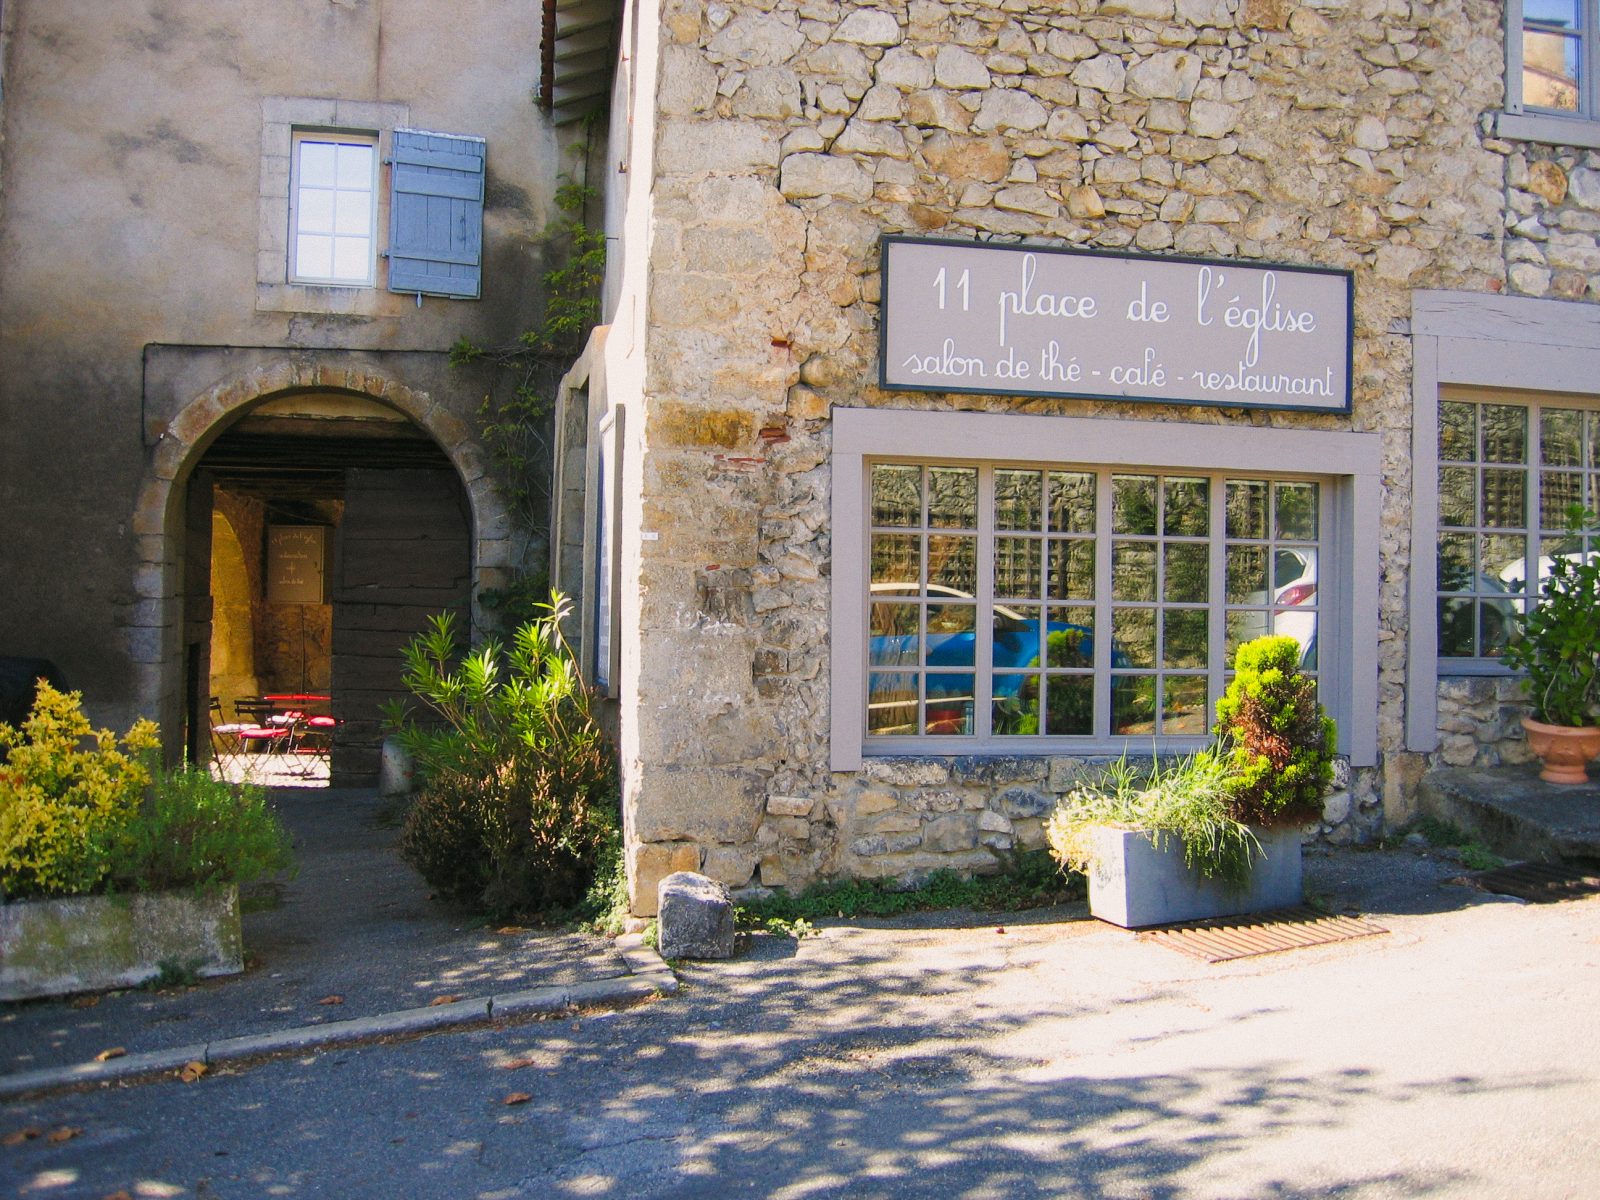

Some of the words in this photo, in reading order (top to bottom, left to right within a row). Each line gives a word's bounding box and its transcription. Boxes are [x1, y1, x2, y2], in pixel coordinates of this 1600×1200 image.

[933, 267, 969, 311] 11
[998, 253, 1098, 346] place
[1126, 280, 1170, 322] de
[1197, 266, 1317, 367] l'église
[902, 338, 987, 377] salon
[994, 347, 1031, 379] de
[1039, 340, 1081, 381] thé
[1109, 347, 1167, 387] café
[1191, 361, 1334, 396] restaurant
